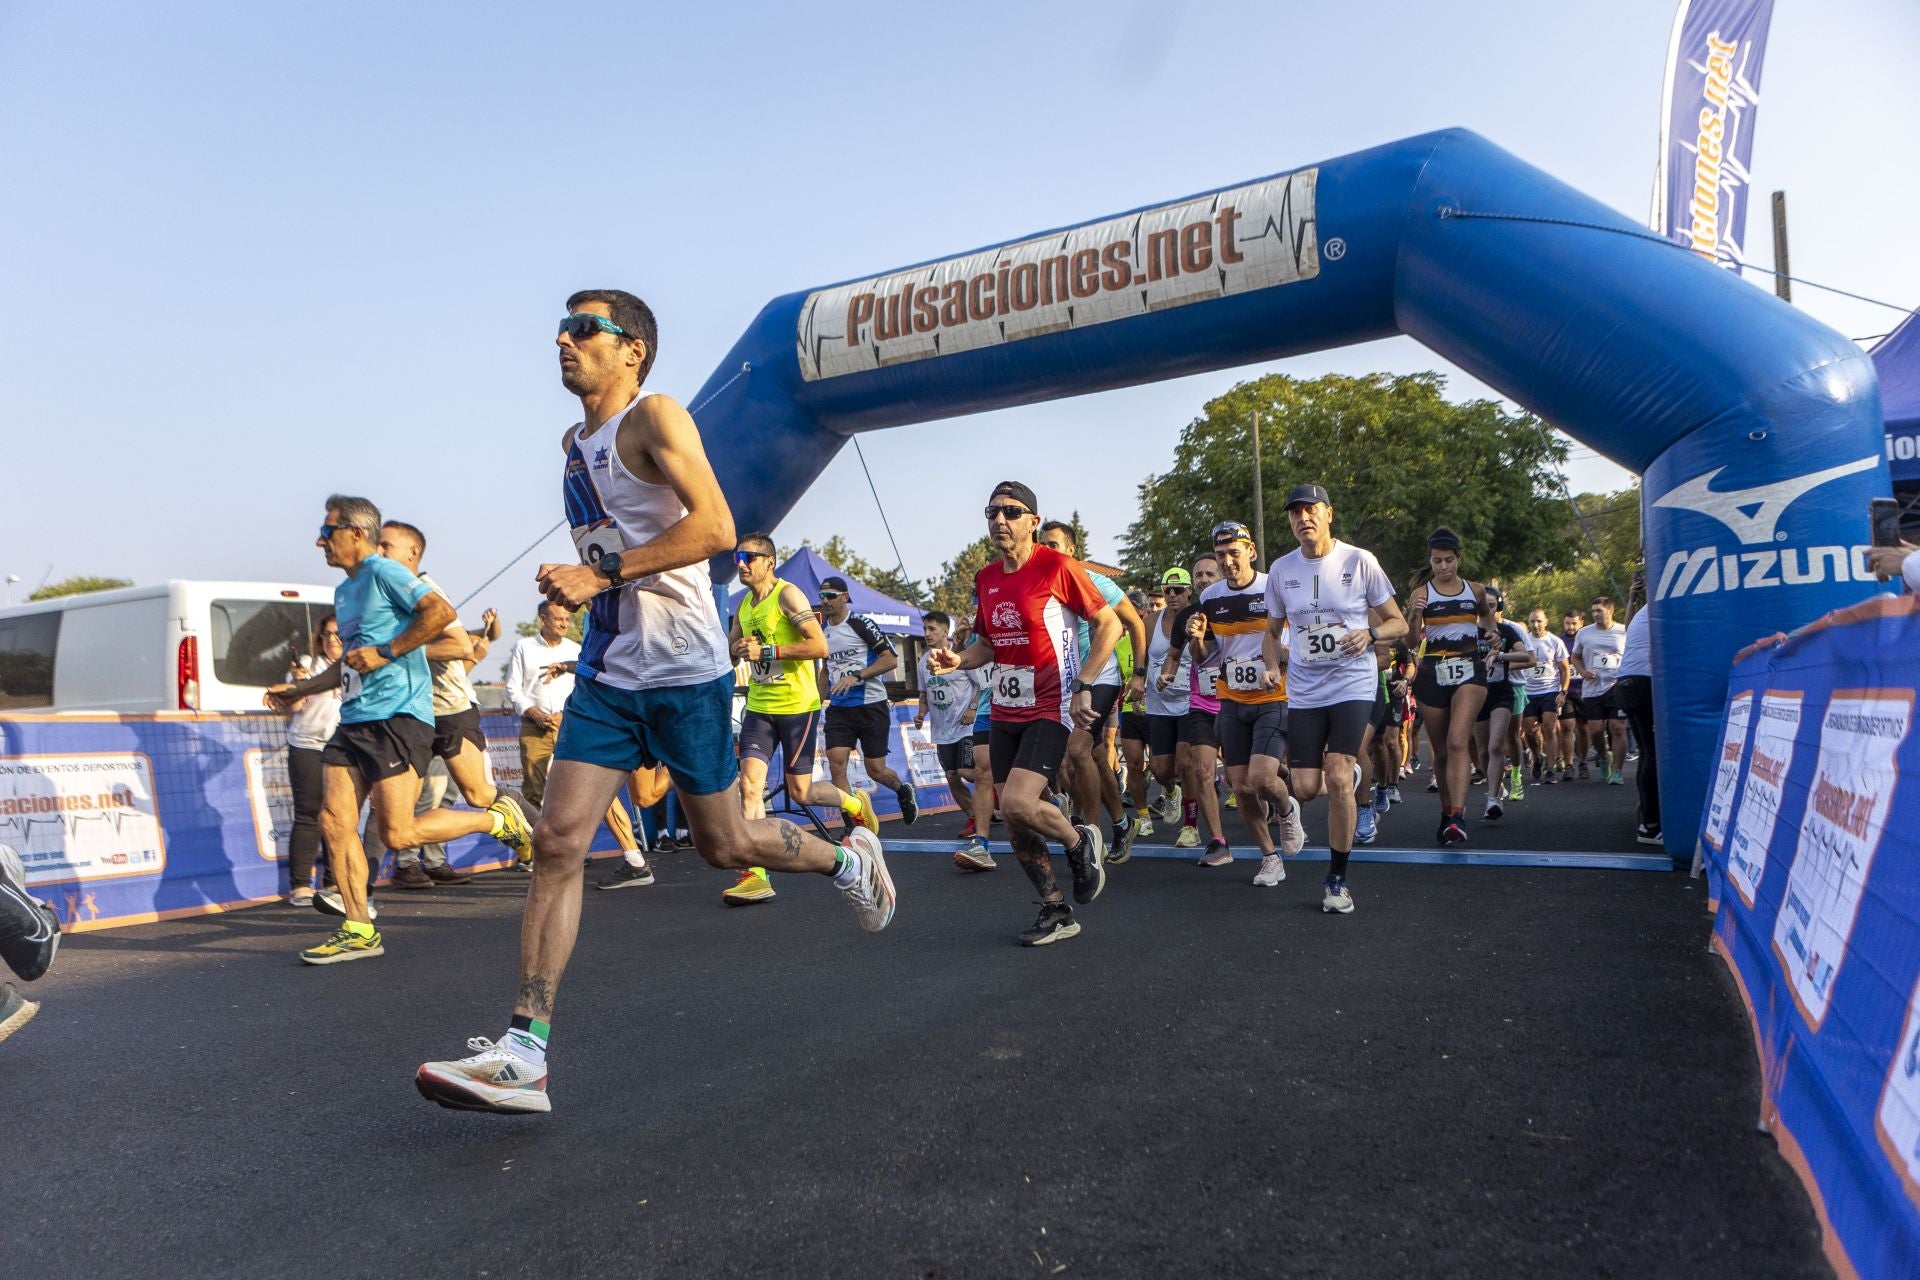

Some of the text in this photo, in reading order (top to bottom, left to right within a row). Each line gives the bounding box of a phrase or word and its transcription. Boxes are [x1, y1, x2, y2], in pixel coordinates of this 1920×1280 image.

[847, 206, 1245, 347] Pulsaciones.net
[1308, 633, 1336, 654] 30
[1601, 657, 1608, 665] 9
[1234, 666, 1258, 684] 88
[1447, 665, 1465, 680] 15
[1535, 666, 1546, 675] 57
[932, 689, 945, 701] 10
[999, 676, 1021, 699] 68
[17, 765, 32, 775] DE
[34, 763, 80, 775] EVENTOS
[83, 761, 143, 773] DEPORTIVOS
